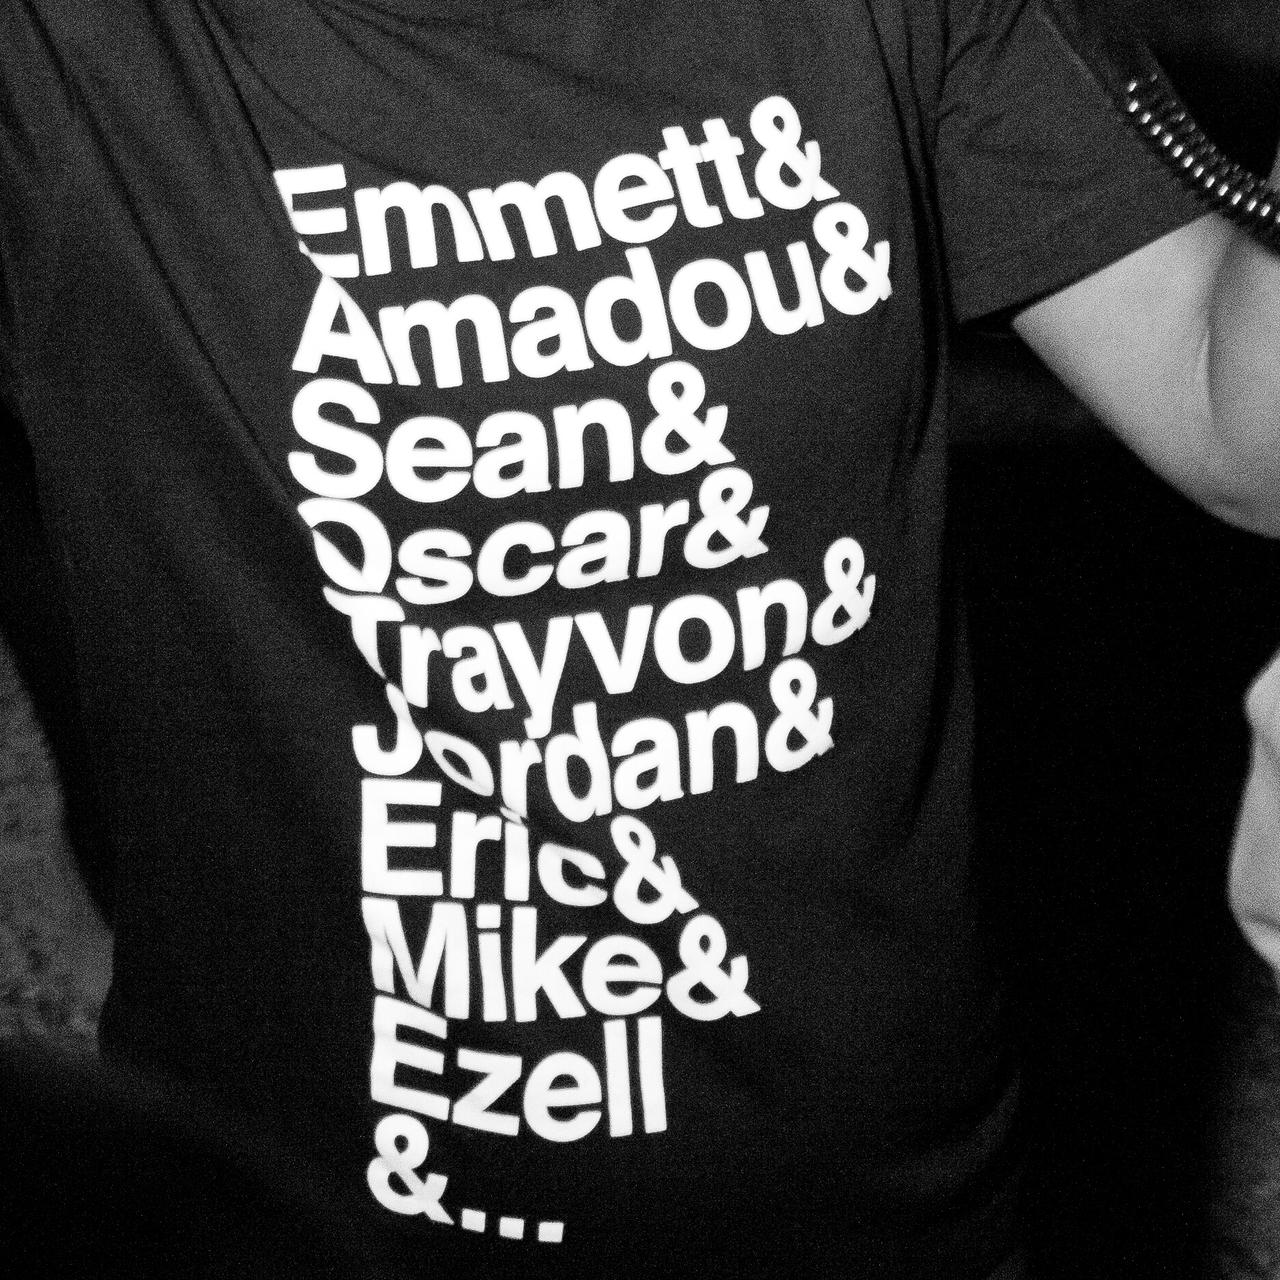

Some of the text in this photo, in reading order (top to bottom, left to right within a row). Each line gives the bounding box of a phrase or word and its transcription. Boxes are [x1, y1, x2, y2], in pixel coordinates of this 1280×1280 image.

[274, 95, 840, 279] Emmett&
[291, 201, 893, 389] Amadou&
[287, 360, 737, 504] Sean&
[297, 467, 770, 606] Oscar&
[323, 536, 876, 739] Trayvon&
[351, 658, 835, 823] Jordan&
[361, 777, 699, 925] Eric&
[361, 896, 761, 1023] Mike&
[370, 994, 668, 1143] Ezell
